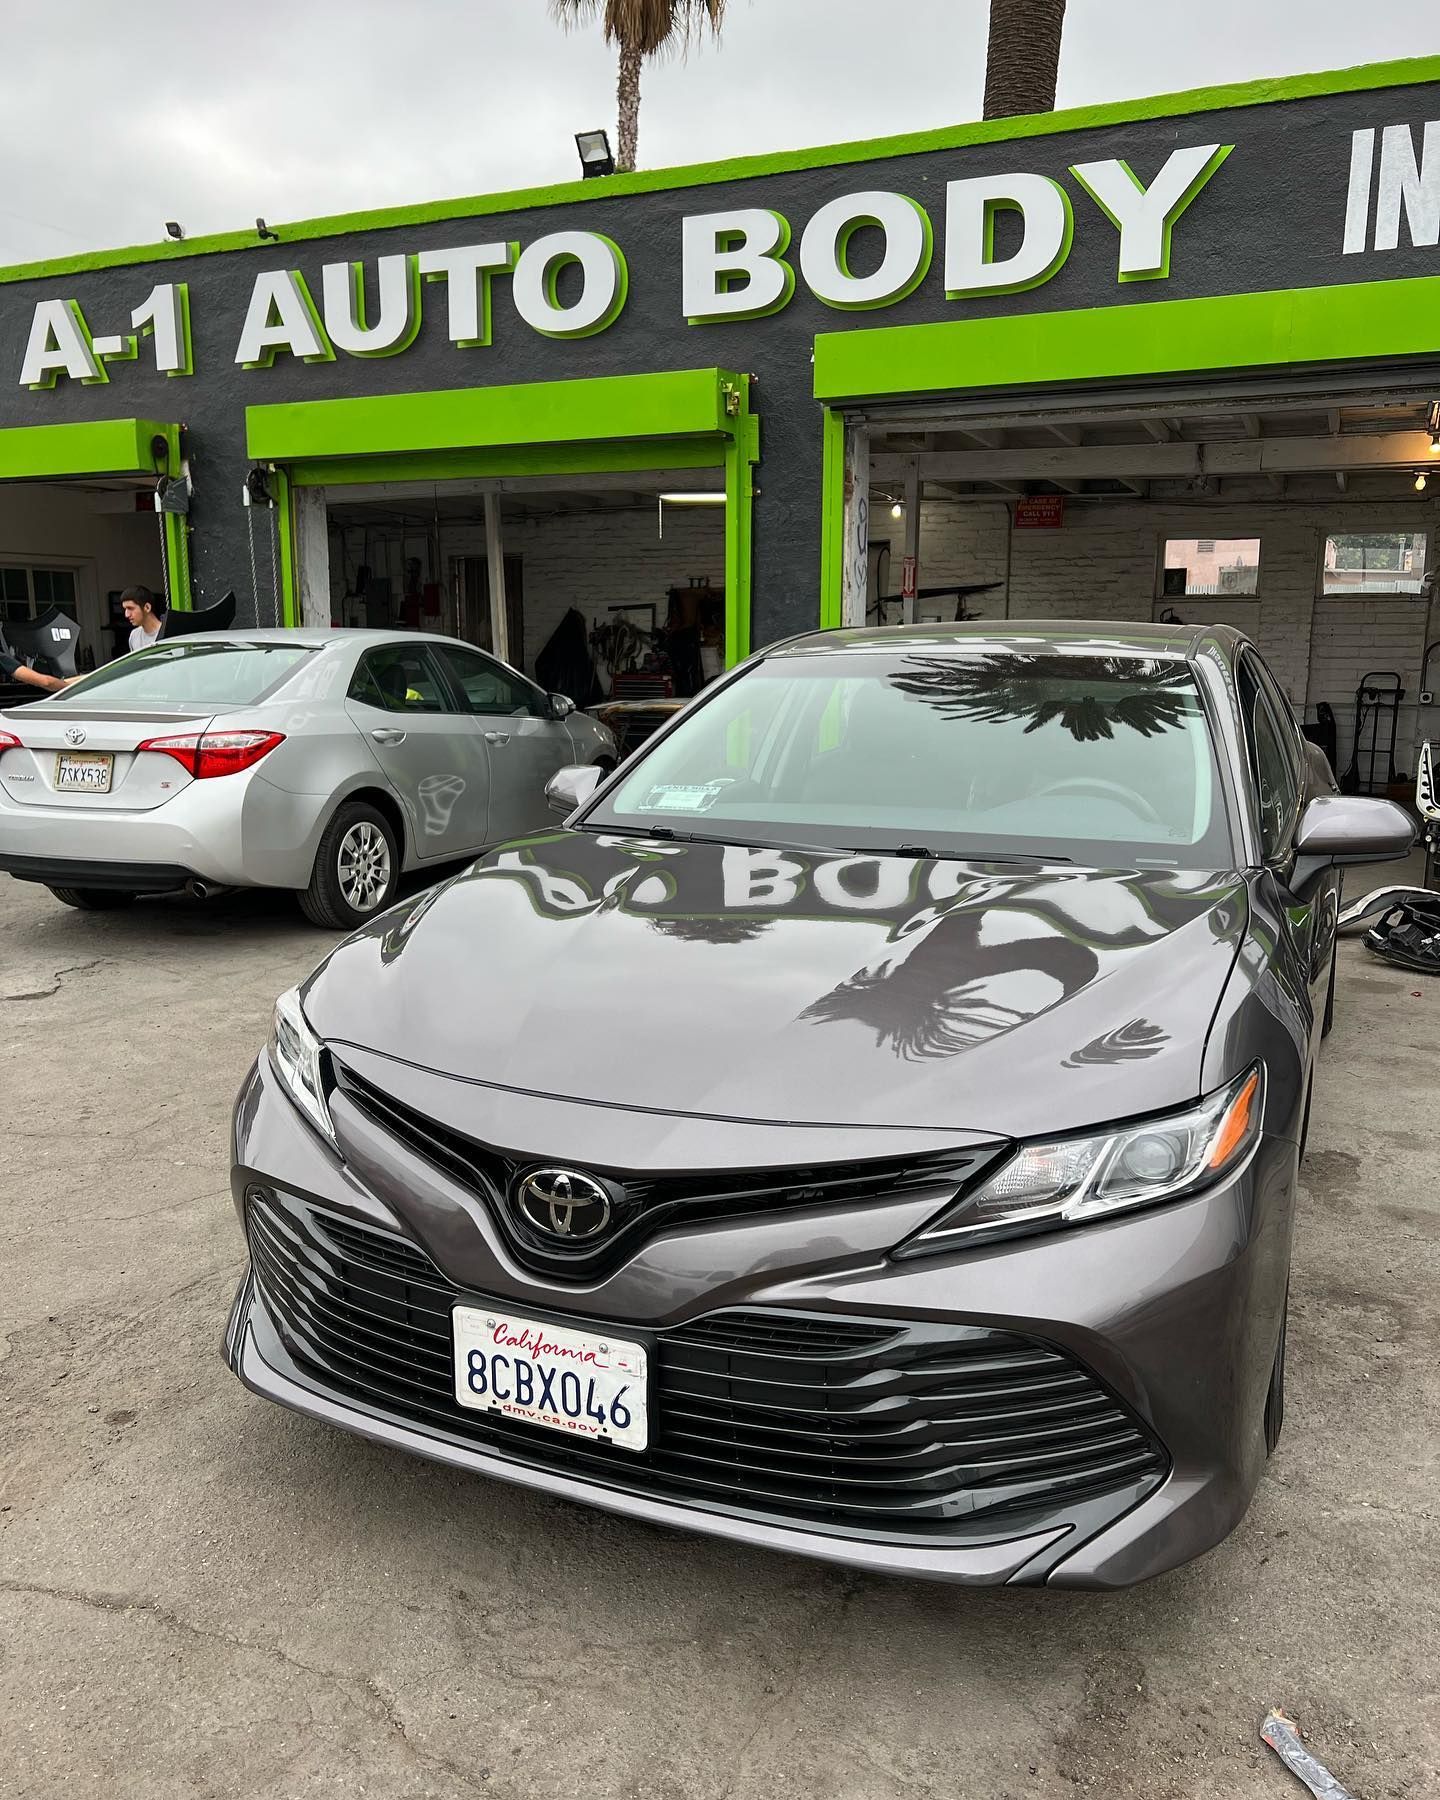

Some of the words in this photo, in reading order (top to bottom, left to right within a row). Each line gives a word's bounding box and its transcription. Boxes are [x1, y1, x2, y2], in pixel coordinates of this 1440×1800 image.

[19, 283, 190, 388] A-1
[235, 231, 624, 367] AUTO
[682, 143, 1230, 322] BODY
[492, 1322, 609, 1369] California
[467, 1349, 631, 1429] 8CBX046
[502, 1403, 598, 1433] dmv.ca.gov
